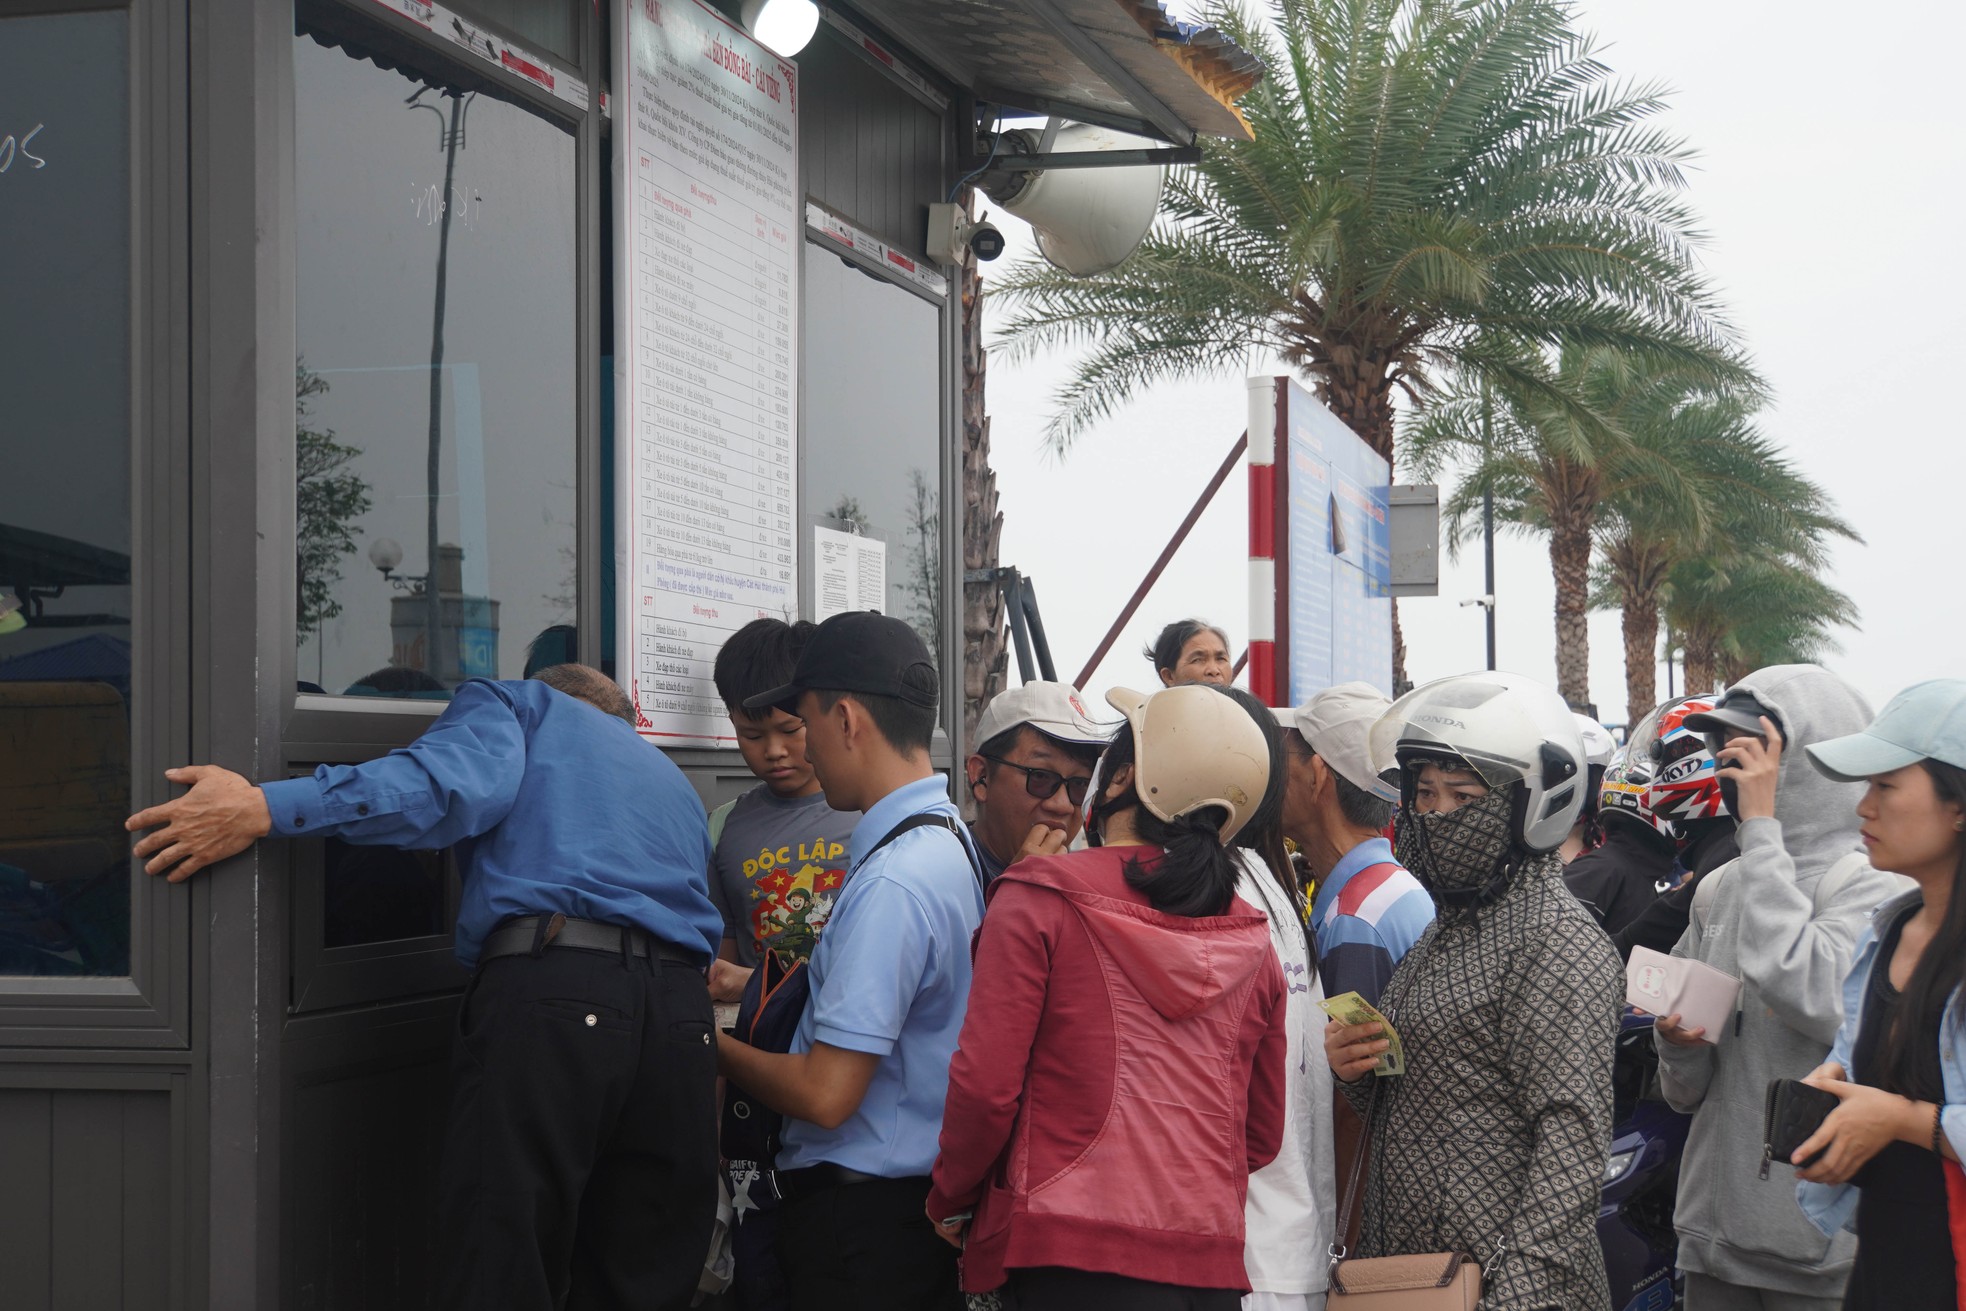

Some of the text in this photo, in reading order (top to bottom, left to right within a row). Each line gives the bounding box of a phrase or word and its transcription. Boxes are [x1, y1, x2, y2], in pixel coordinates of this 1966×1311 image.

[742, 837, 844, 879] ĐỘC LẬP
[1632, 1266, 1669, 1292] HONDA
